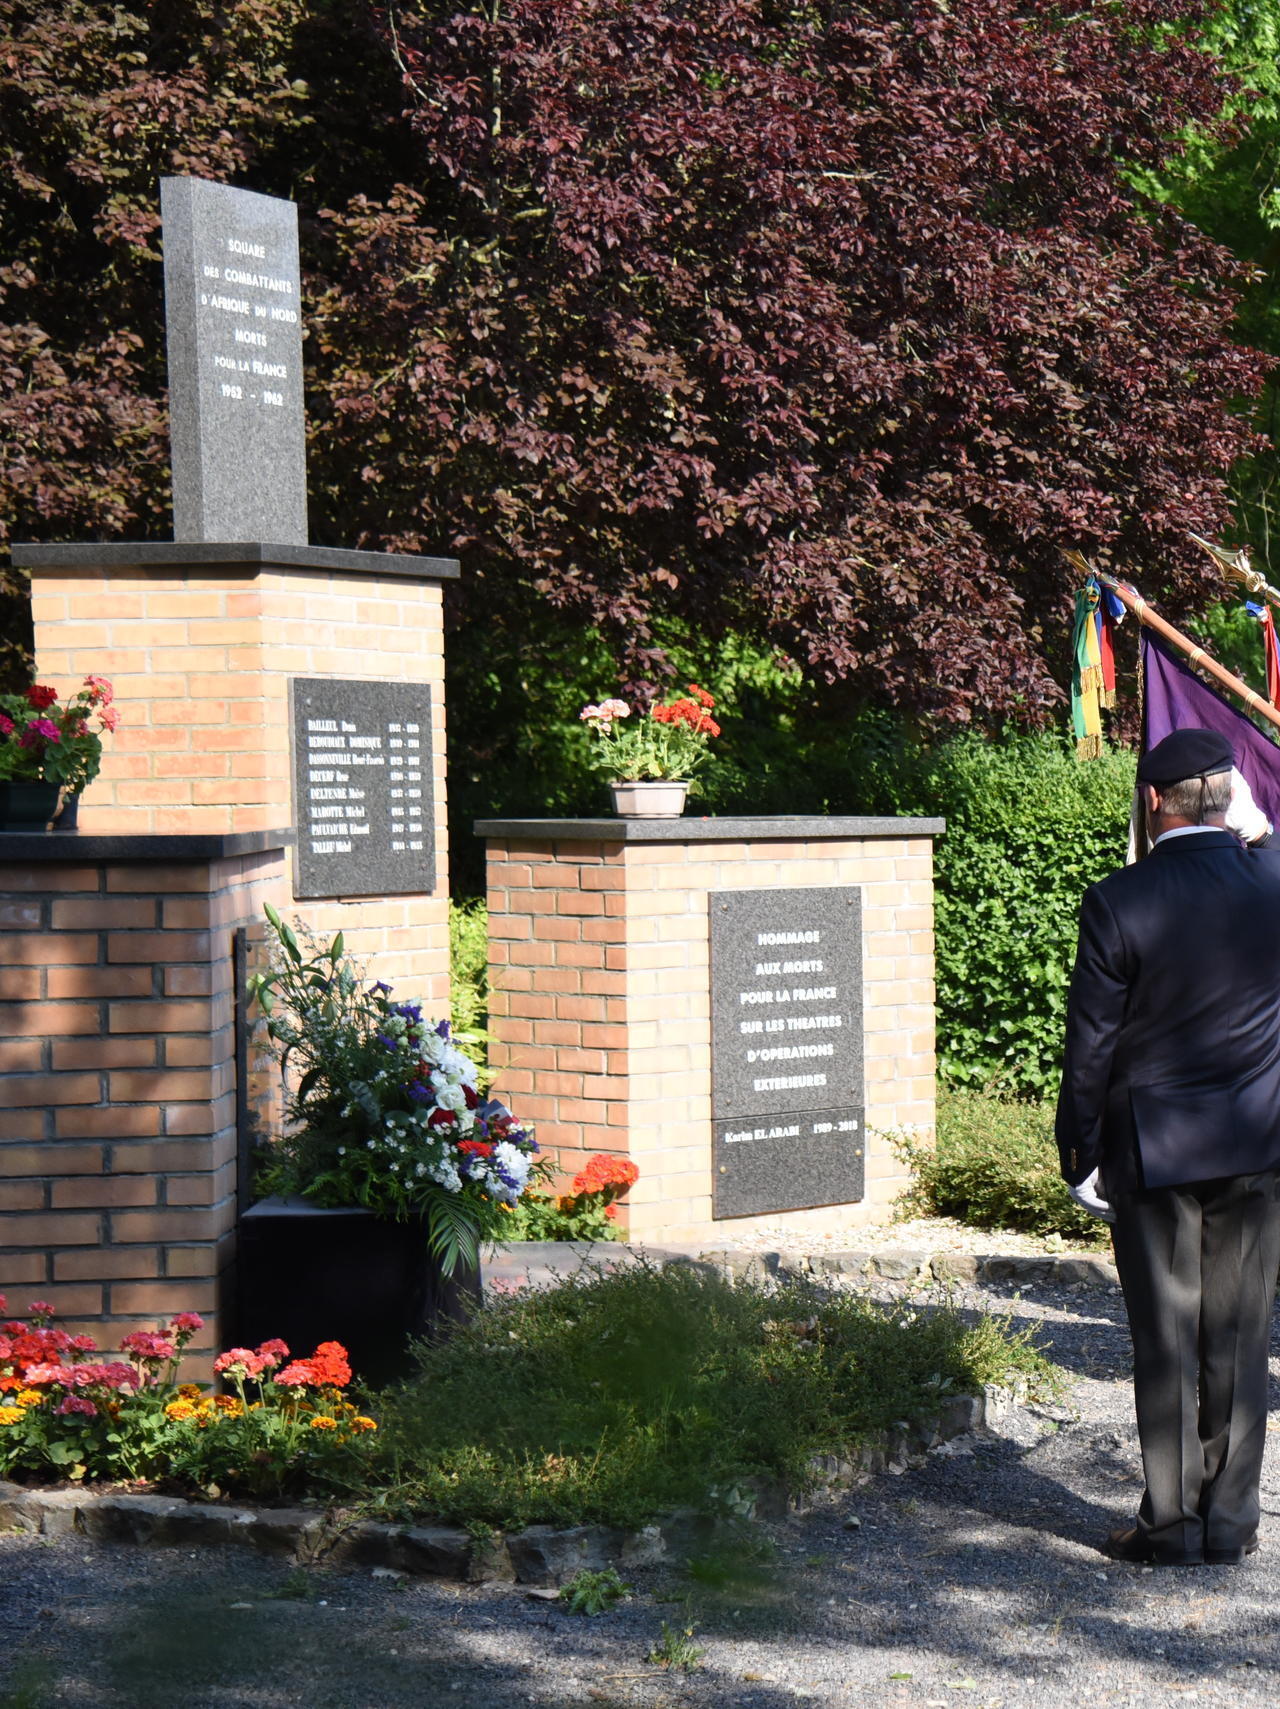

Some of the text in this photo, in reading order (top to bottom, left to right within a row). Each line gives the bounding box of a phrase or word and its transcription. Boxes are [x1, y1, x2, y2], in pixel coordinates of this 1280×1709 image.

[229, 239, 265, 257] SQUARE
[204, 266, 292, 293] DES COMBATTANTS
[202, 294, 297, 322] D'AFRIQUE DU NORD
[236, 329, 266, 346] MORTS
[215, 356, 287, 378] POUR LA FRANCE
[222, 384, 242, 399] 1952
[264, 391, 283, 406] 1962
[758, 931, 819, 945] HOMMAGE
[756, 960, 823, 975] AUX MORTS
[740, 987, 836, 1004] POUR LA FRANCE
[741, 1016, 842, 1033] SUR LES THEATRES
[747, 1044, 833, 1062] D'OPERATIONS
[754, 1074, 826, 1091] EXTERIEURES
[725, 1131, 752, 1142] Karim
